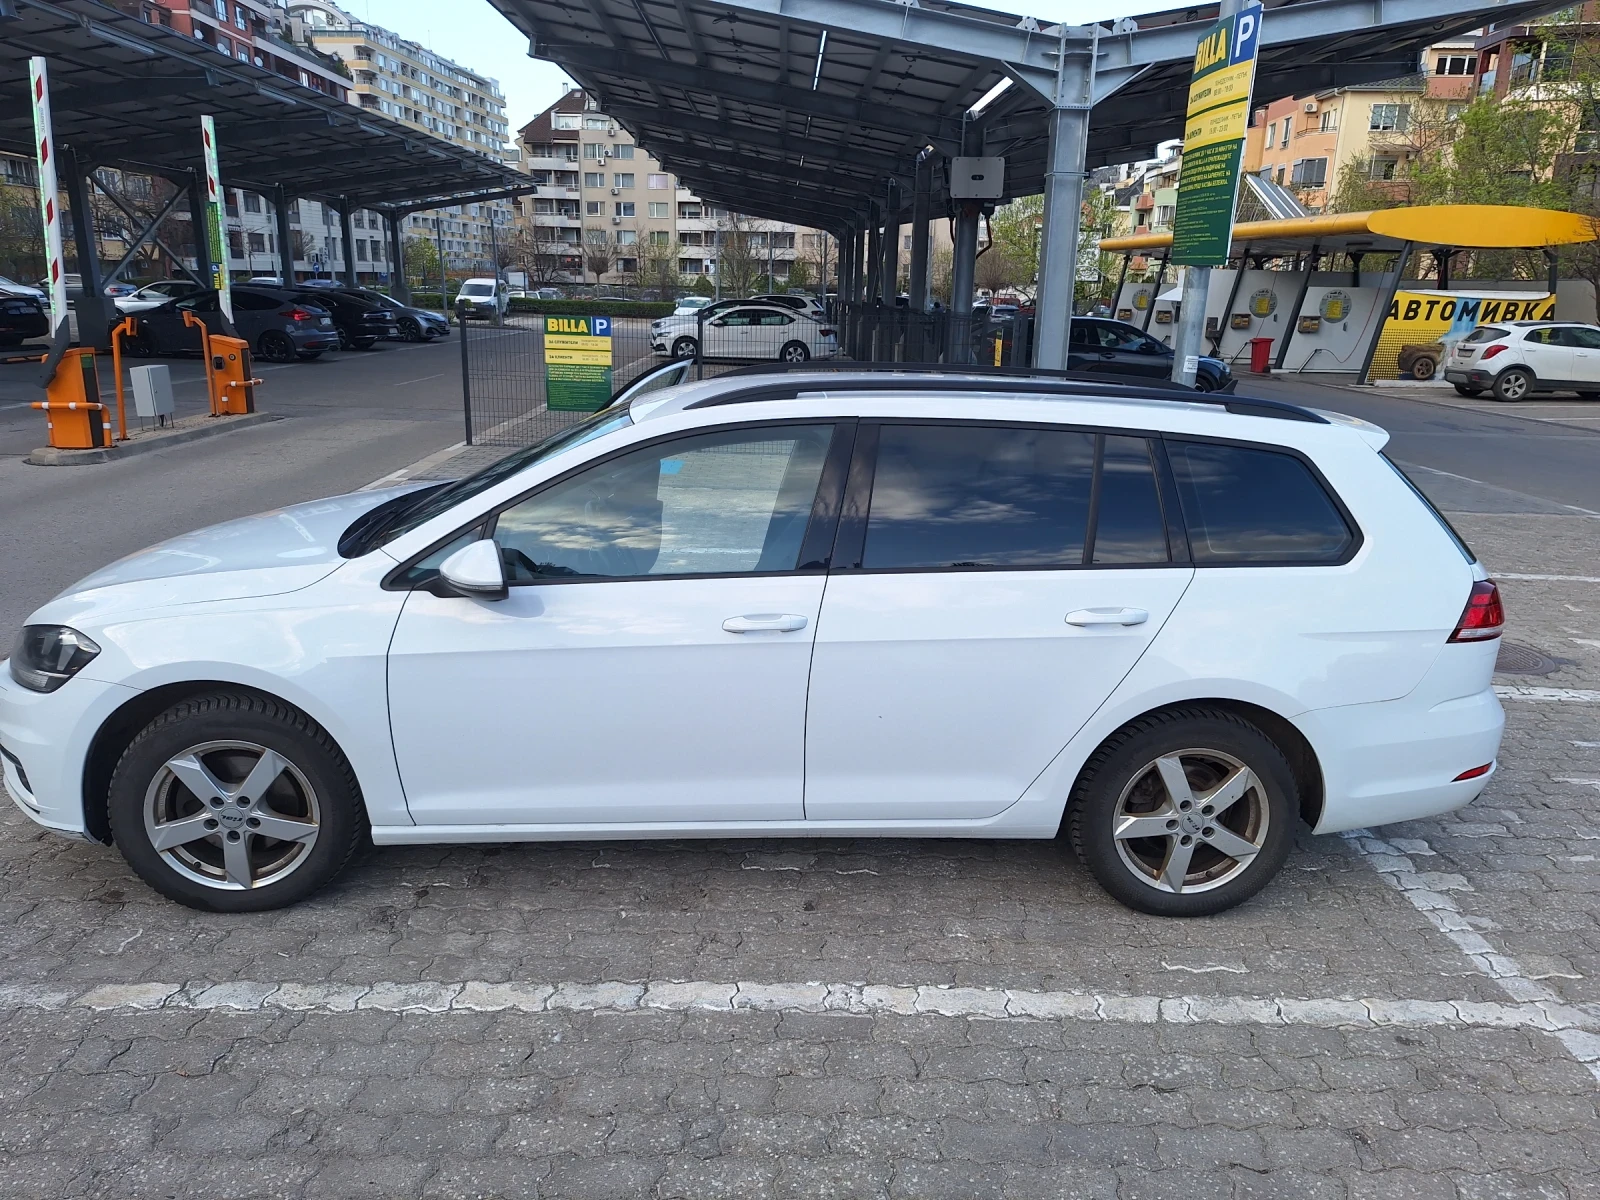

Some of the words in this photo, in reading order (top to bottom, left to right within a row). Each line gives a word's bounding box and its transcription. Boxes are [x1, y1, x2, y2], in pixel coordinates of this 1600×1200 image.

[1193, 28, 1227, 75] BILLA
[1235, 14, 1255, 58] P
[1387, 299, 1555, 322] АВТОМИВКА
[547, 318, 588, 333] BILLA
[595, 319, 608, 335] P
